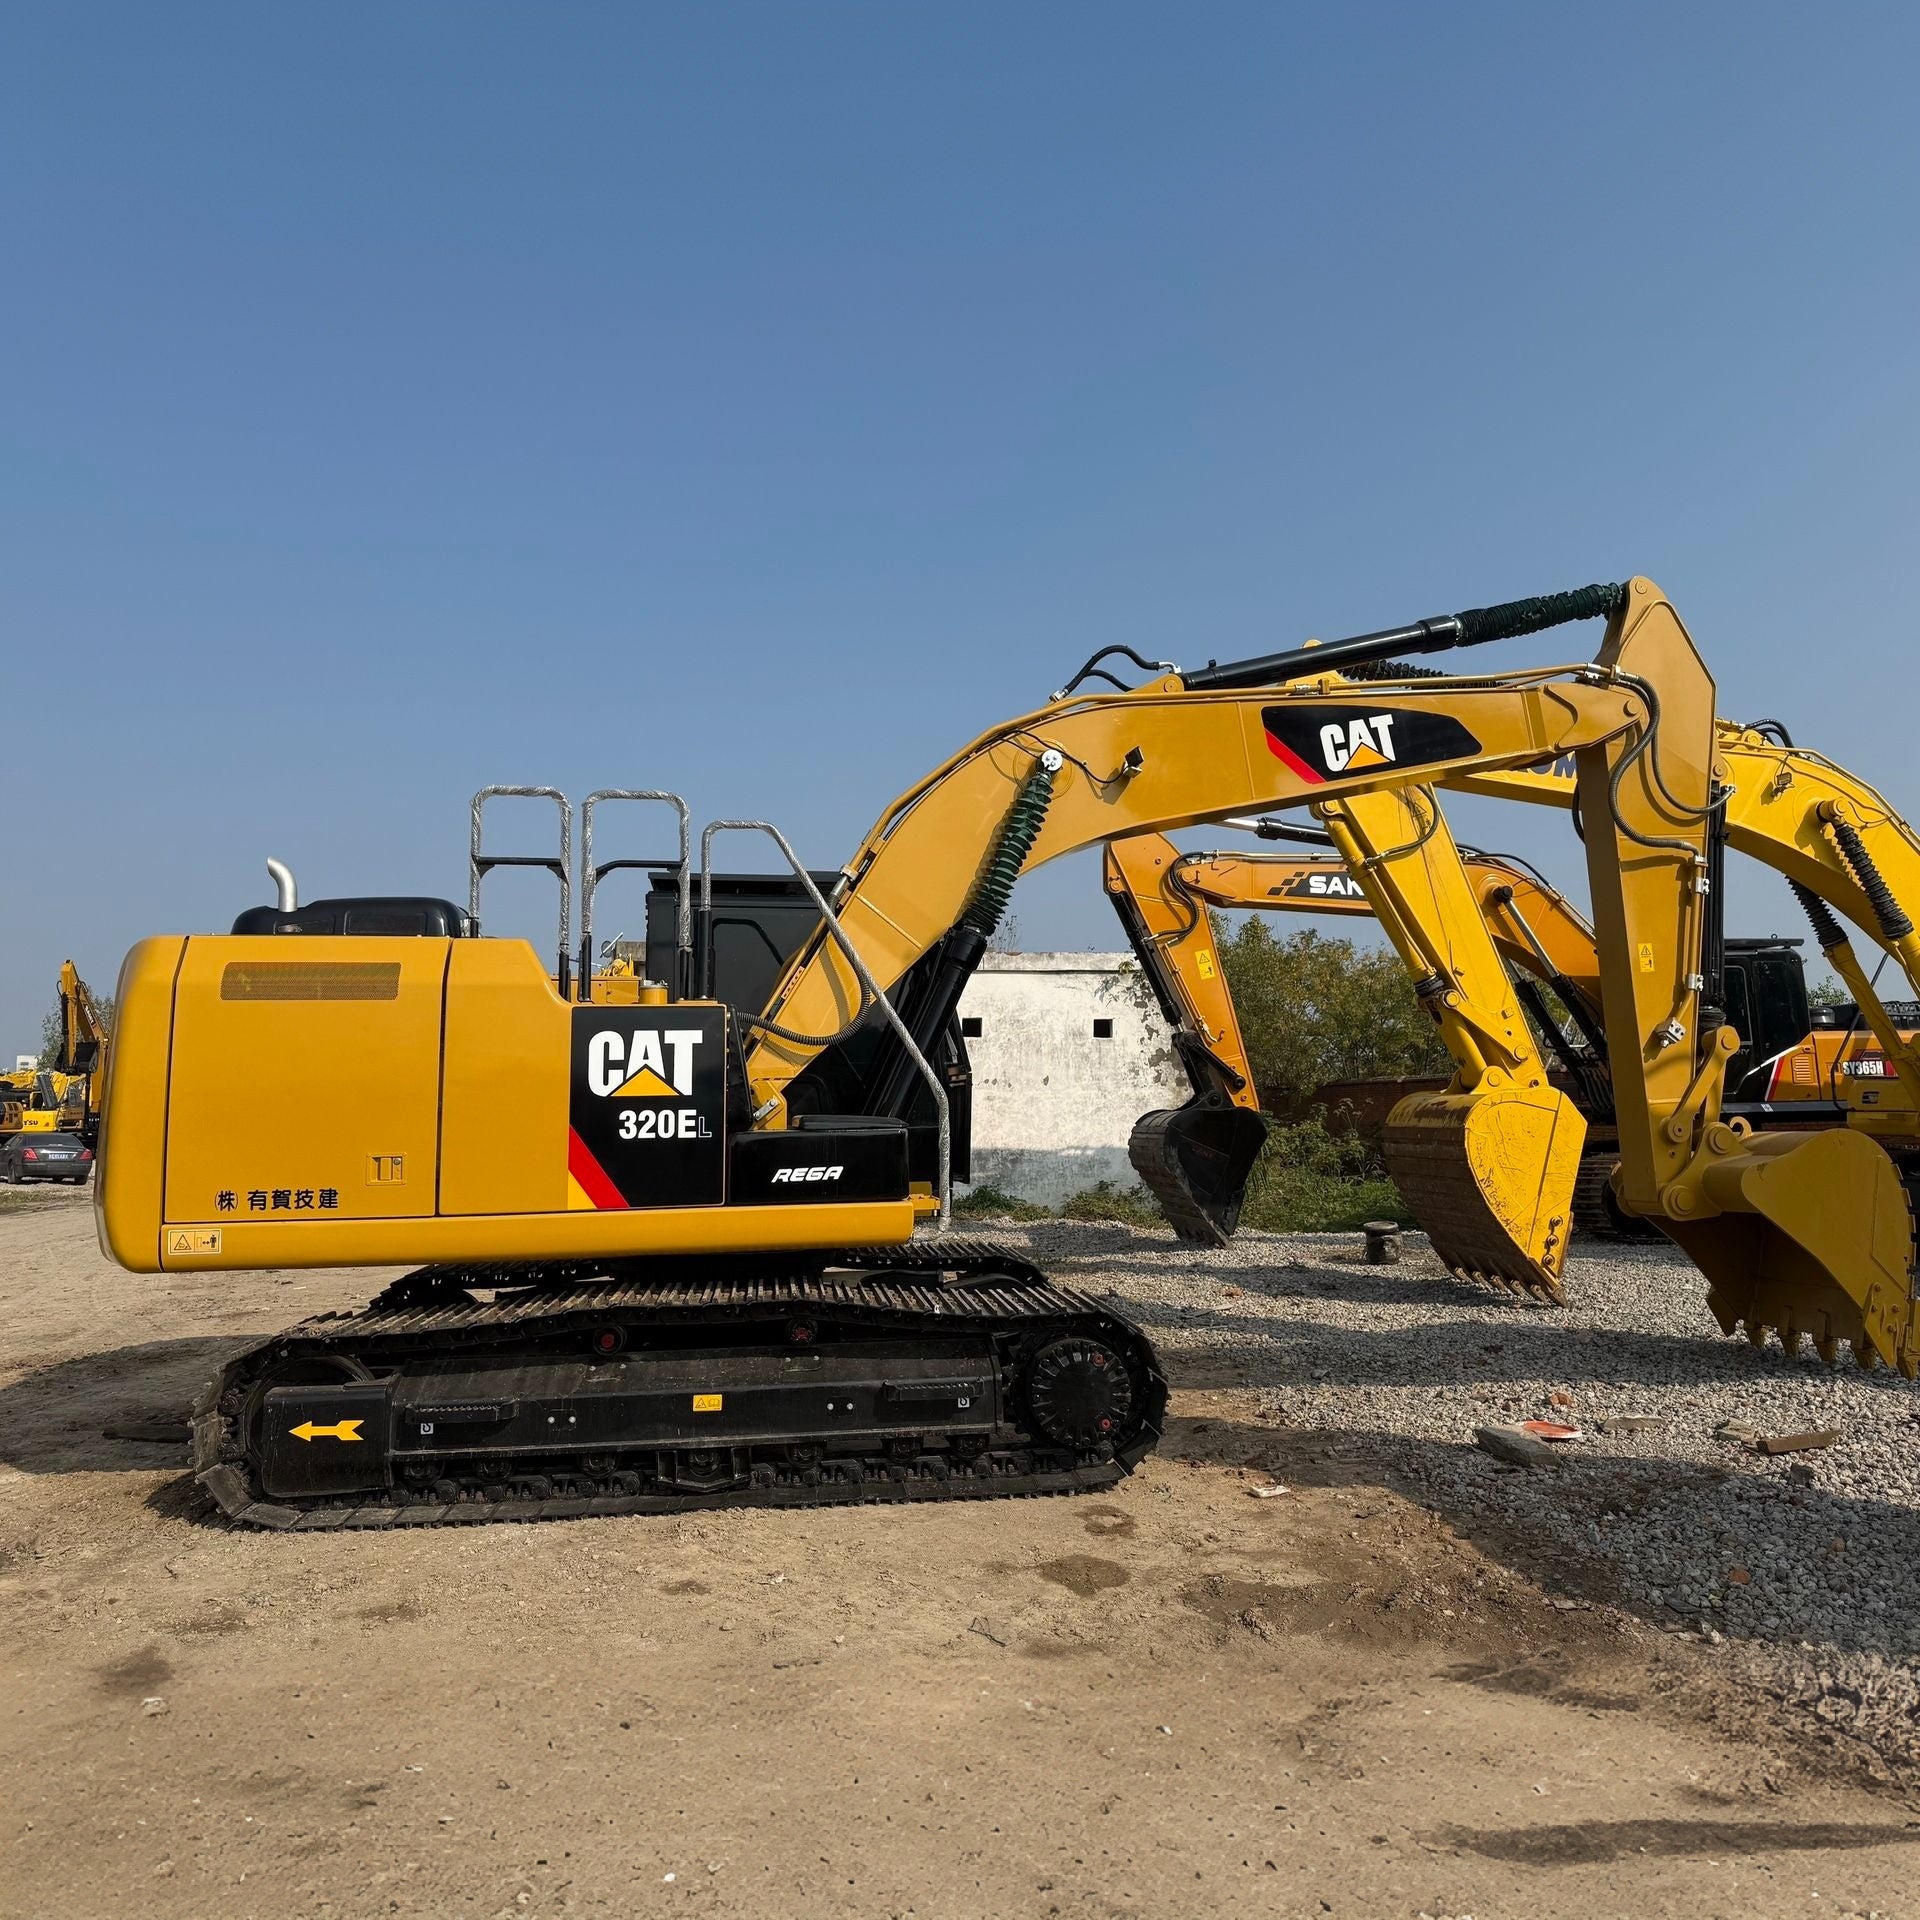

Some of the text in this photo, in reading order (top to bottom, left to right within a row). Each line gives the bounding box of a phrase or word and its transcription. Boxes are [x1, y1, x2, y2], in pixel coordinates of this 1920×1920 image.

[1319, 713, 1396, 772] CAT
[588, 1029, 703, 1097] CAT
[1842, 1060, 1884, 1076] SY365H
[771, 1166, 844, 1183] REGA
[247, 1187, 339, 1211] 有賀技建
